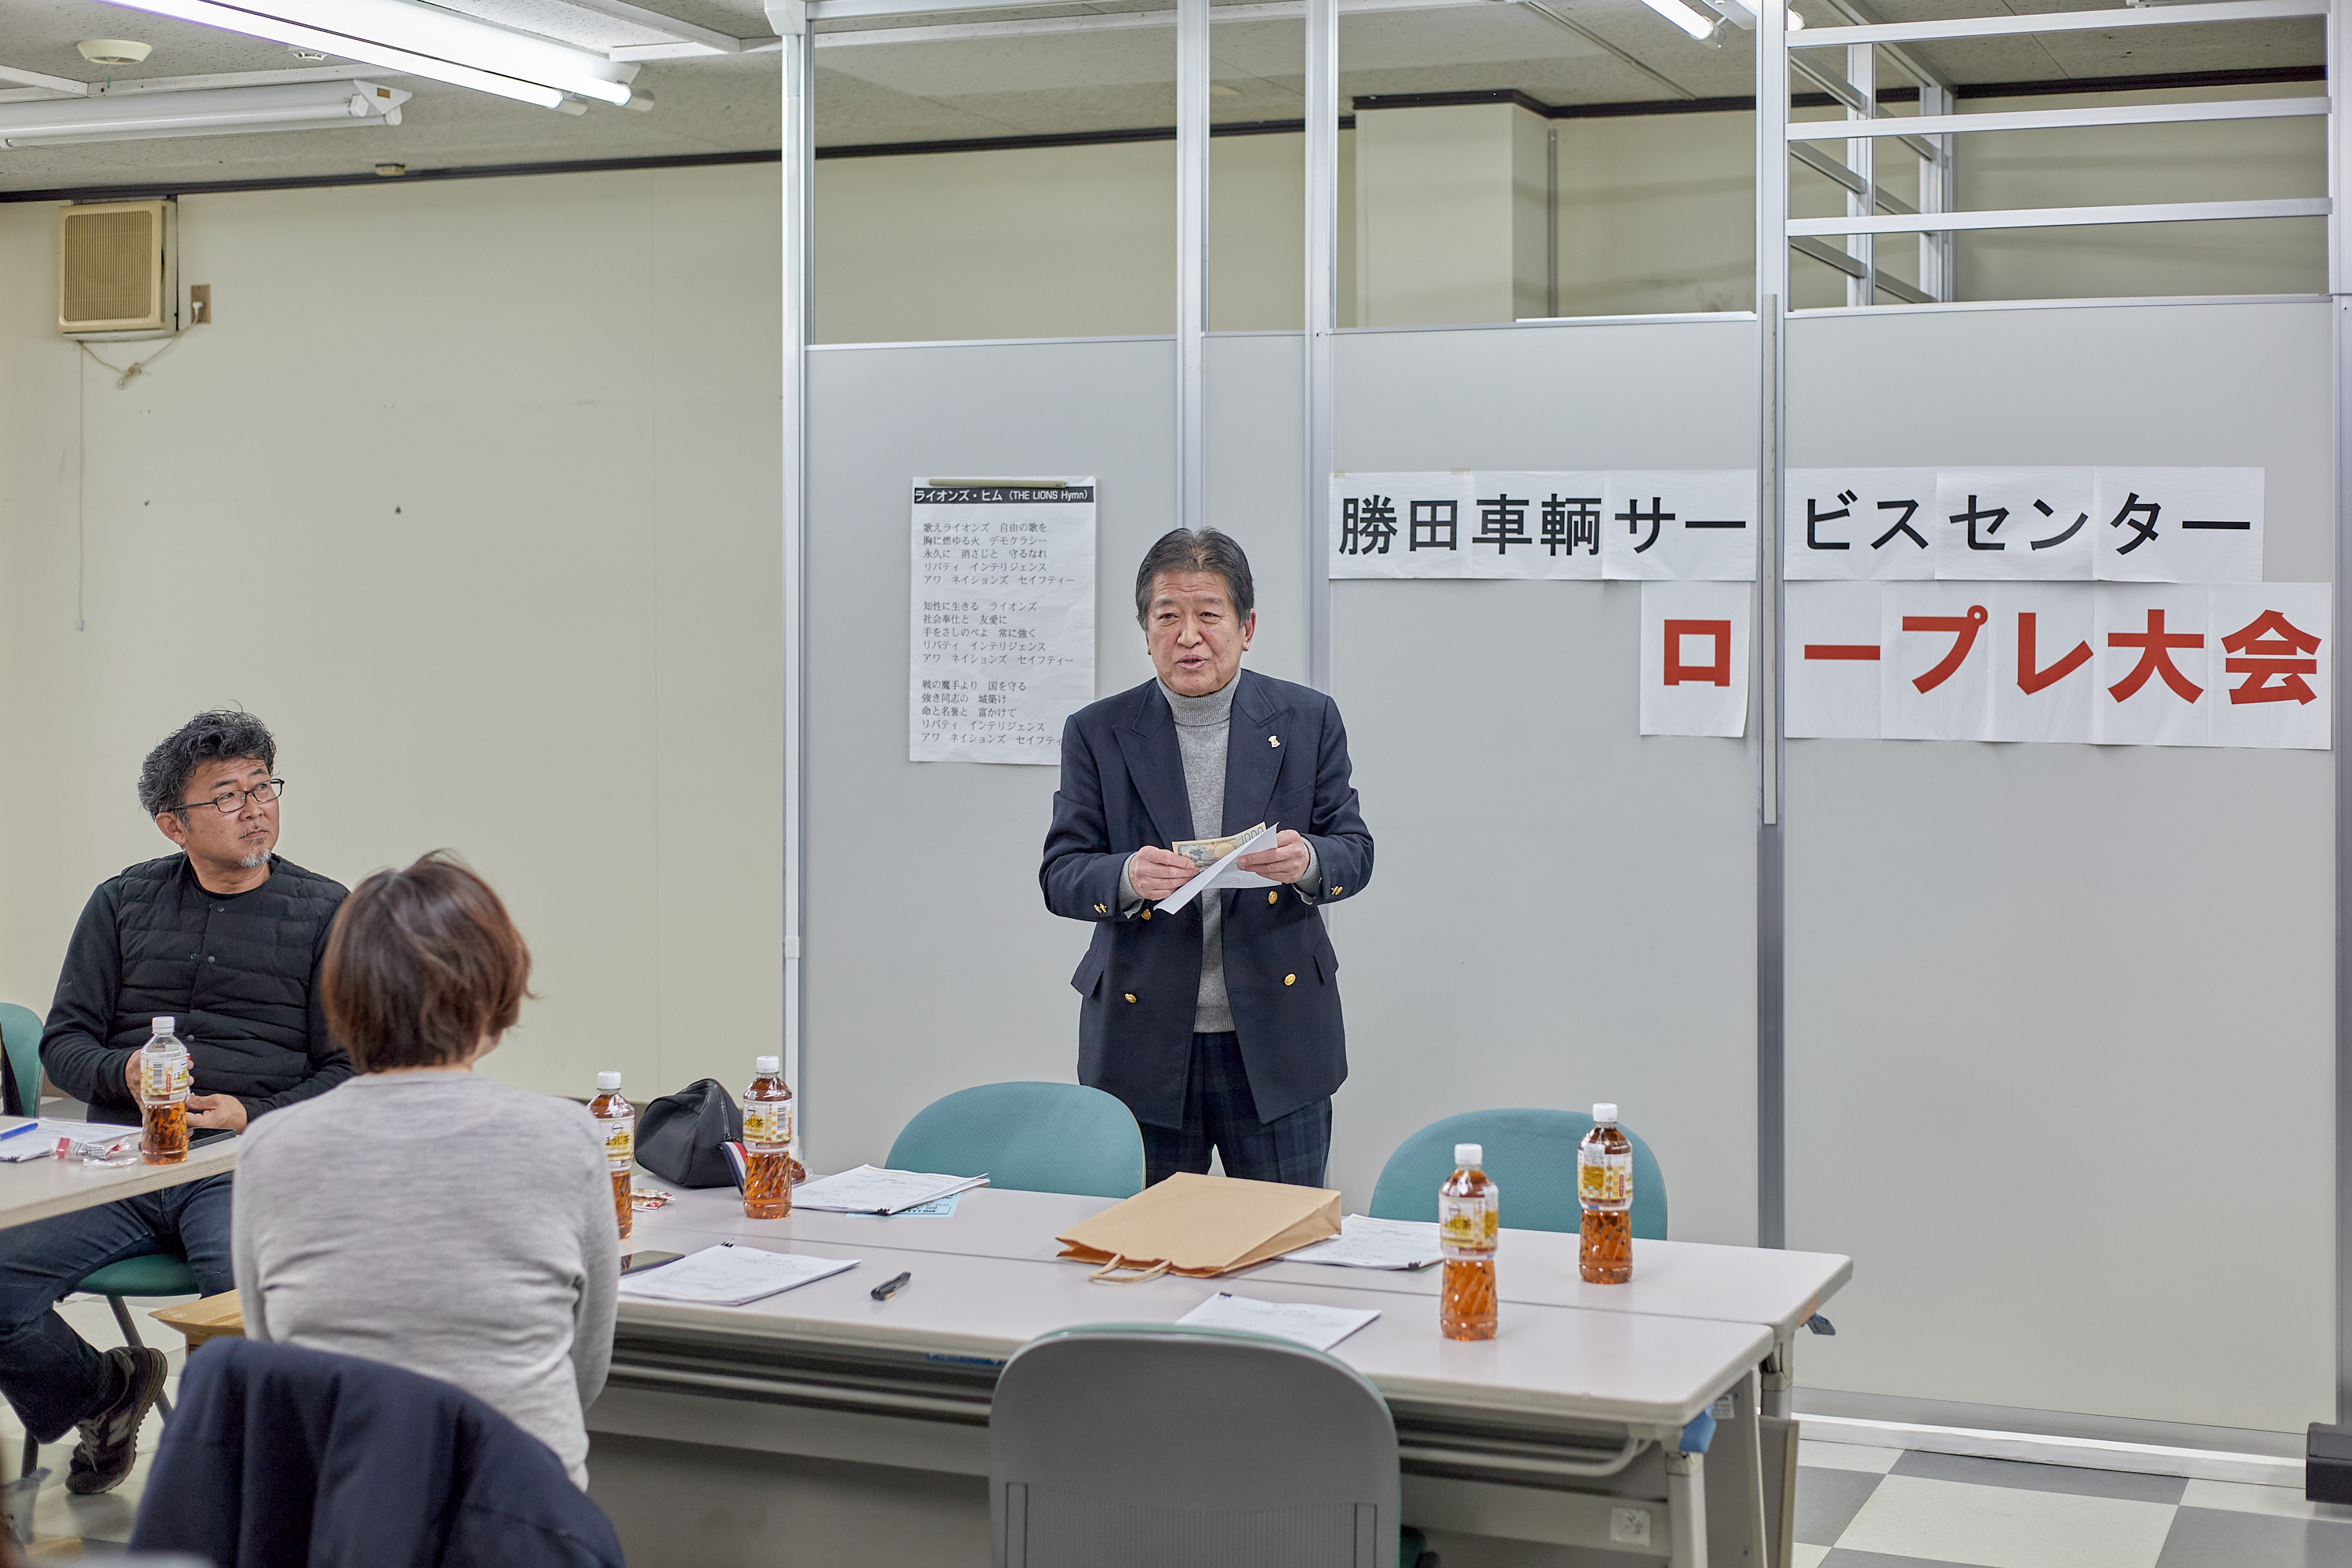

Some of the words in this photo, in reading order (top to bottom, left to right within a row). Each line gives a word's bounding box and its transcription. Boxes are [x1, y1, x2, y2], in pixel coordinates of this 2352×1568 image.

[915, 489, 1003, 502] ライオンズ・ヒム
[1033, 490, 1058, 500] LIONS
[924, 523, 989, 532] 歌えライオンズ
[1000, 523, 1047, 532] 自由の歌を
[924, 535, 980, 546] 胸に燃ゆる火
[990, 535, 1047, 546] デモクラシー
[924, 549, 950, 558] 永久に
[962, 550, 997, 559] 消さじと
[1009, 549, 1047, 559] 守るなれ
[925, 562, 958, 572] リバティ
[971, 563, 1046, 572] インテリジェンス
[924, 575, 941, 584] アワ
[953, 575, 1009, 585] ネイションズ
[1018, 575, 1074, 585] セイフティー
[924, 601, 978, 611] 知性に生きる
[990, 601, 1037, 612] ライオンズ
[924, 614, 969, 624] 社会奉仕と
[980, 615, 1007, 625] 友愛に
[924, 627, 988, 637] 手をさしのべよ
[999, 628, 1035, 638] 常に強く
[924, 641, 958, 650] リバティ
[971, 641, 1045, 651] インテリジェンス
[924, 654, 940, 662] アワ
[952, 654, 1007, 664] ネイションズ
[1018, 655, 1073, 666] セイフティー
[1664, 604, 2321, 706] ロープレ大会
[923, 680, 977, 690] 戦の魔手より
[989, 681, 1025, 691] 国を守る
[922, 692, 968, 703] 強き同志の
[978, 694, 1007, 704] 城築け
[922, 706, 967, 717] 命と名誉と
[978, 707, 1016, 717] 富かけて
[923, 720, 957, 729] リバティ
[970, 720, 1044, 731] インテリジェンス
[922, 733, 939, 742] アワ
[951, 733, 1006, 743] ネイションズ
